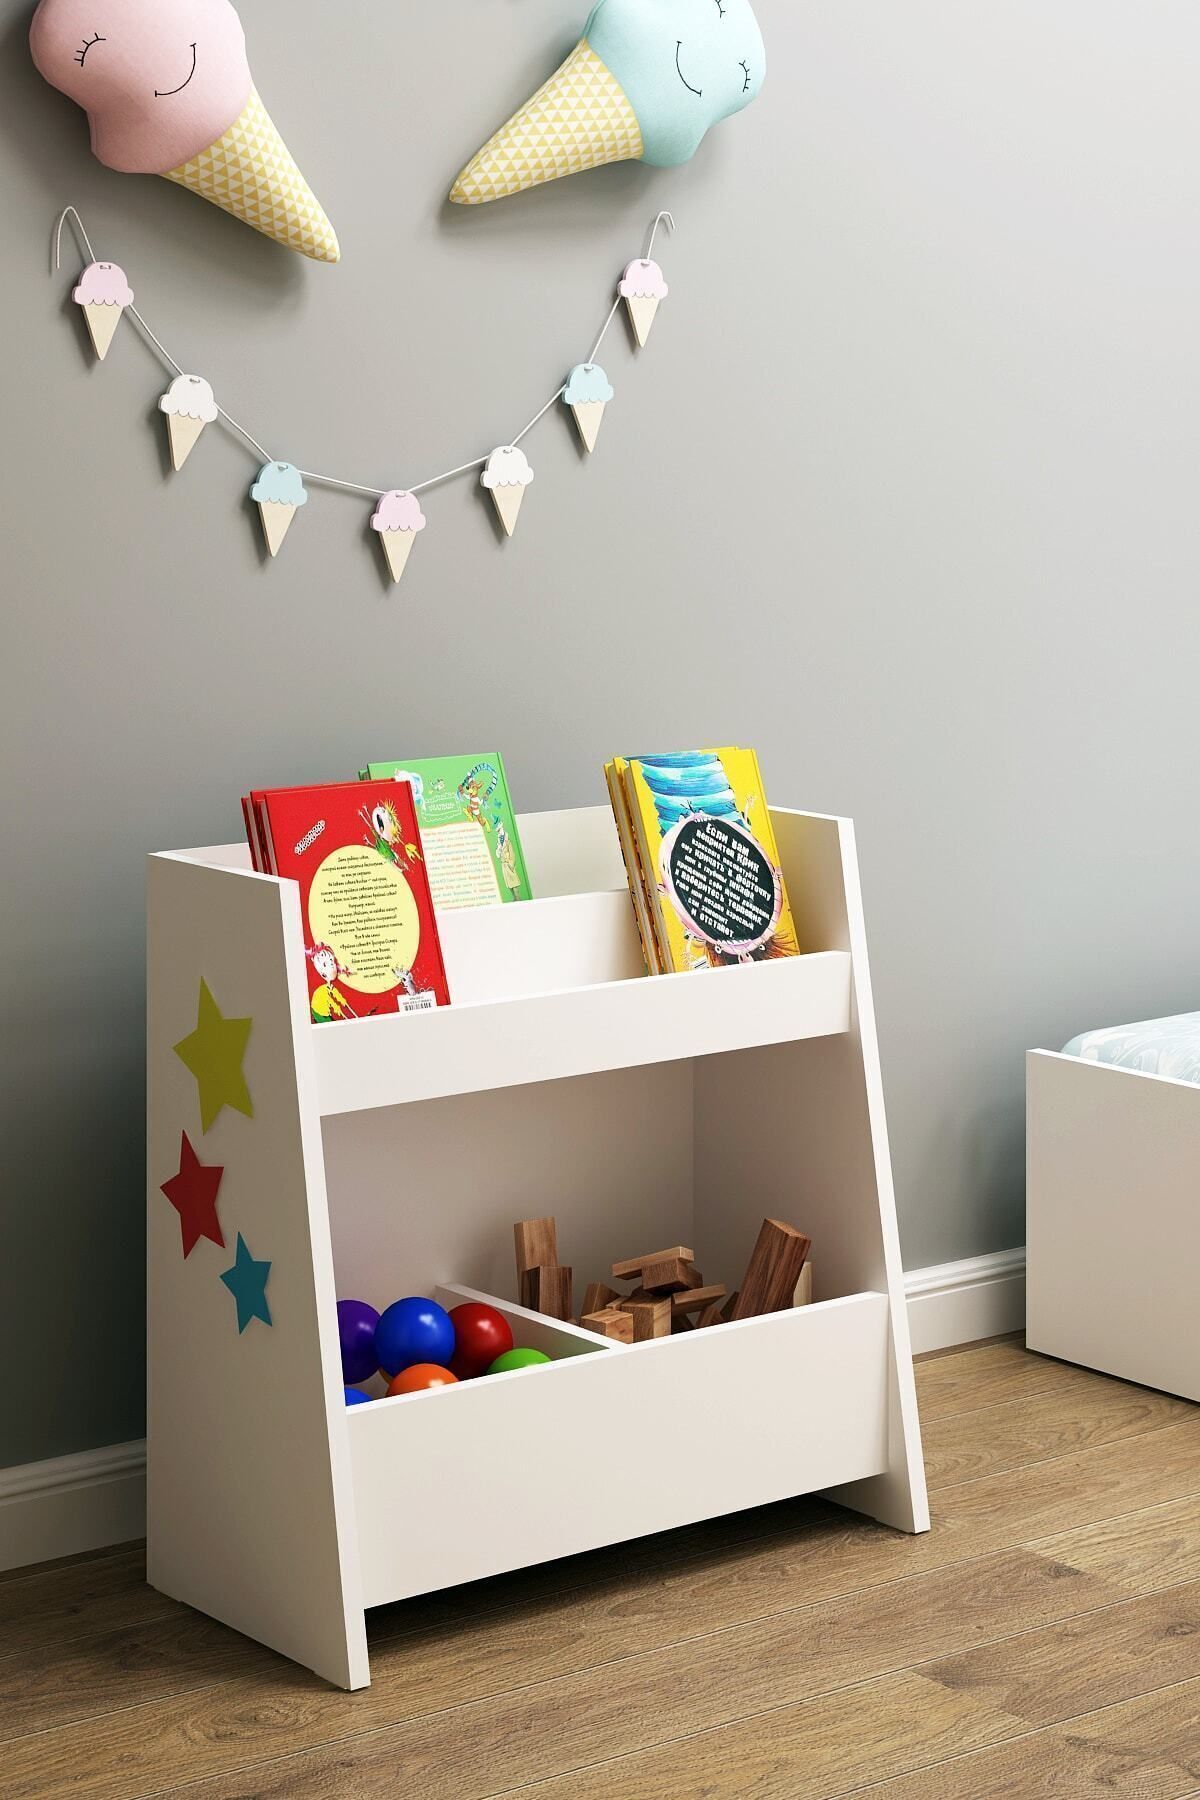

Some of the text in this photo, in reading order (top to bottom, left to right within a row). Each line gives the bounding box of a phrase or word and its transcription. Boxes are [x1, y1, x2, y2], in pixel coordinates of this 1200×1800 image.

[706, 823, 749, 857] Если вам
[695, 849, 724, 872] кричать
[736, 873, 771, 901] форточку
[737, 852, 760, 873] крик
